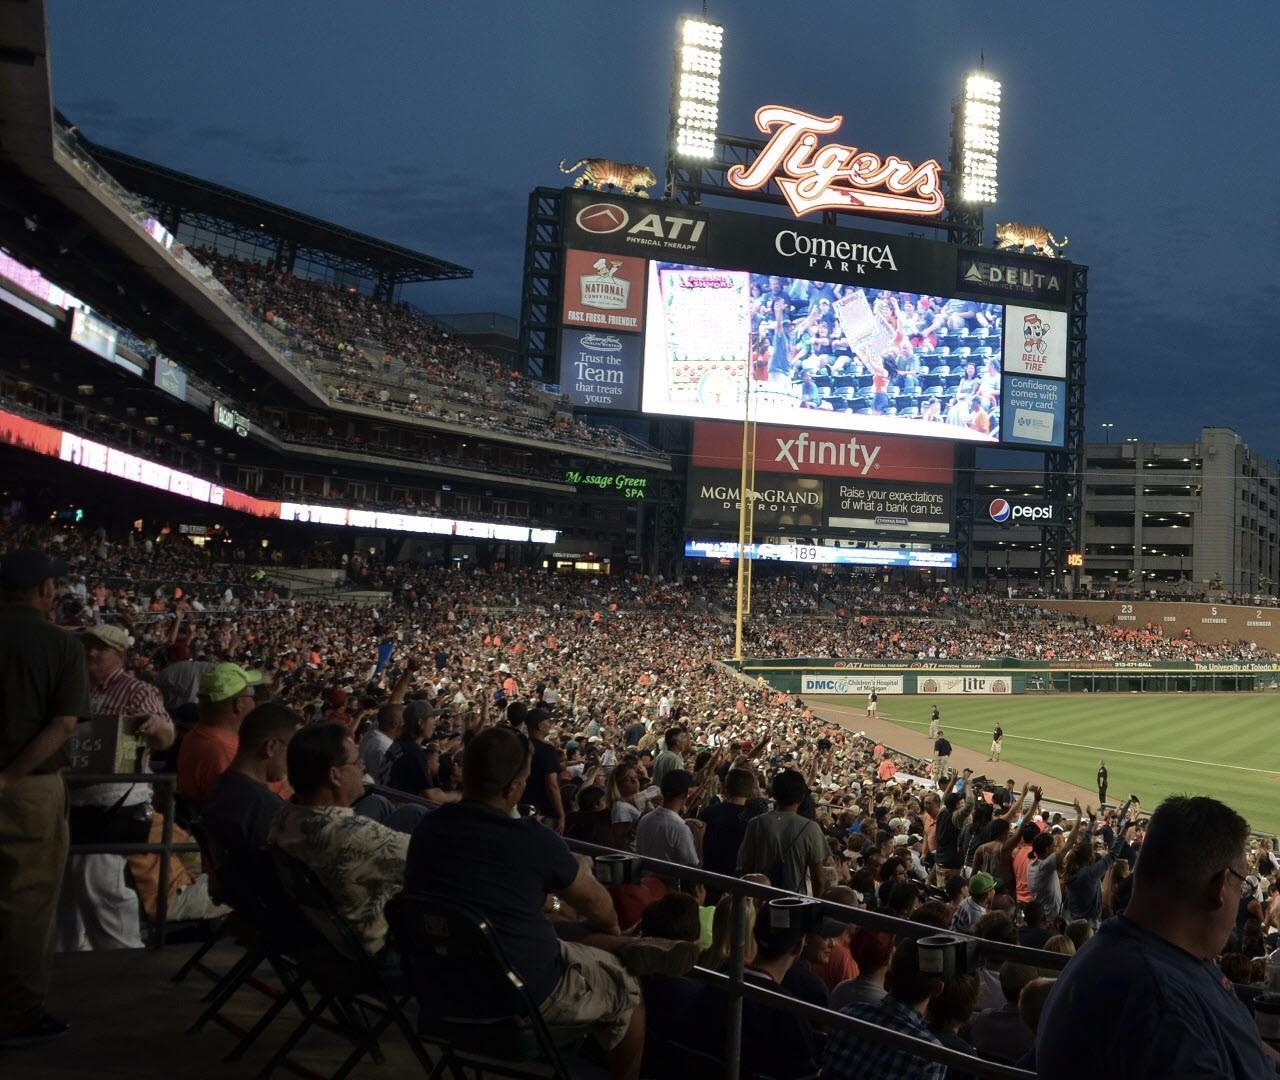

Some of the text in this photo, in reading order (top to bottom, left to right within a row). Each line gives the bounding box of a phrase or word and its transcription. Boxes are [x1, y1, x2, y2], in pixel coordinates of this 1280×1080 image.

[727, 104, 945, 218] Tigers
[628, 213, 706, 242] ATI
[626, 236, 696, 251] PHYSICAL THERAPY
[809, 257, 866, 274] PARK
[989, 266, 1060, 291] DELTA
[584, 282, 625, 297] NATIONAL
[579, 351, 622, 366] Trust the
[1021, 353, 1047, 364] BELLE
[574, 361, 624, 384] Team
[1024, 362, 1043, 371] TIRE
[575, 381, 622, 395] that treats
[1011, 378, 1058, 392] Confidence
[584, 394, 612, 405] yours
[1010, 388, 1058, 401] comes with
[1010, 399, 1034, 410] every
[775, 432, 881, 475] xfinity
[615, 474, 647, 489] Green
[625, 488, 645, 498] SPA
[700, 485, 820, 505] MGM GRAND
[839, 485, 943, 504] Raise your expectations
[723, 501, 798, 513] DETROIT
[840, 499, 944, 515] of what a bank can be.
[1012, 505, 1052, 520] pepsi
[1121, 604, 1133, 614] 23
[1256, 610, 1262, 619] 2
[1207, 663, 1241, 671] University
[806, 680, 834, 690] DMC
[877, 679, 899, 687] Hospital
[963, 677, 986, 692] Lite
